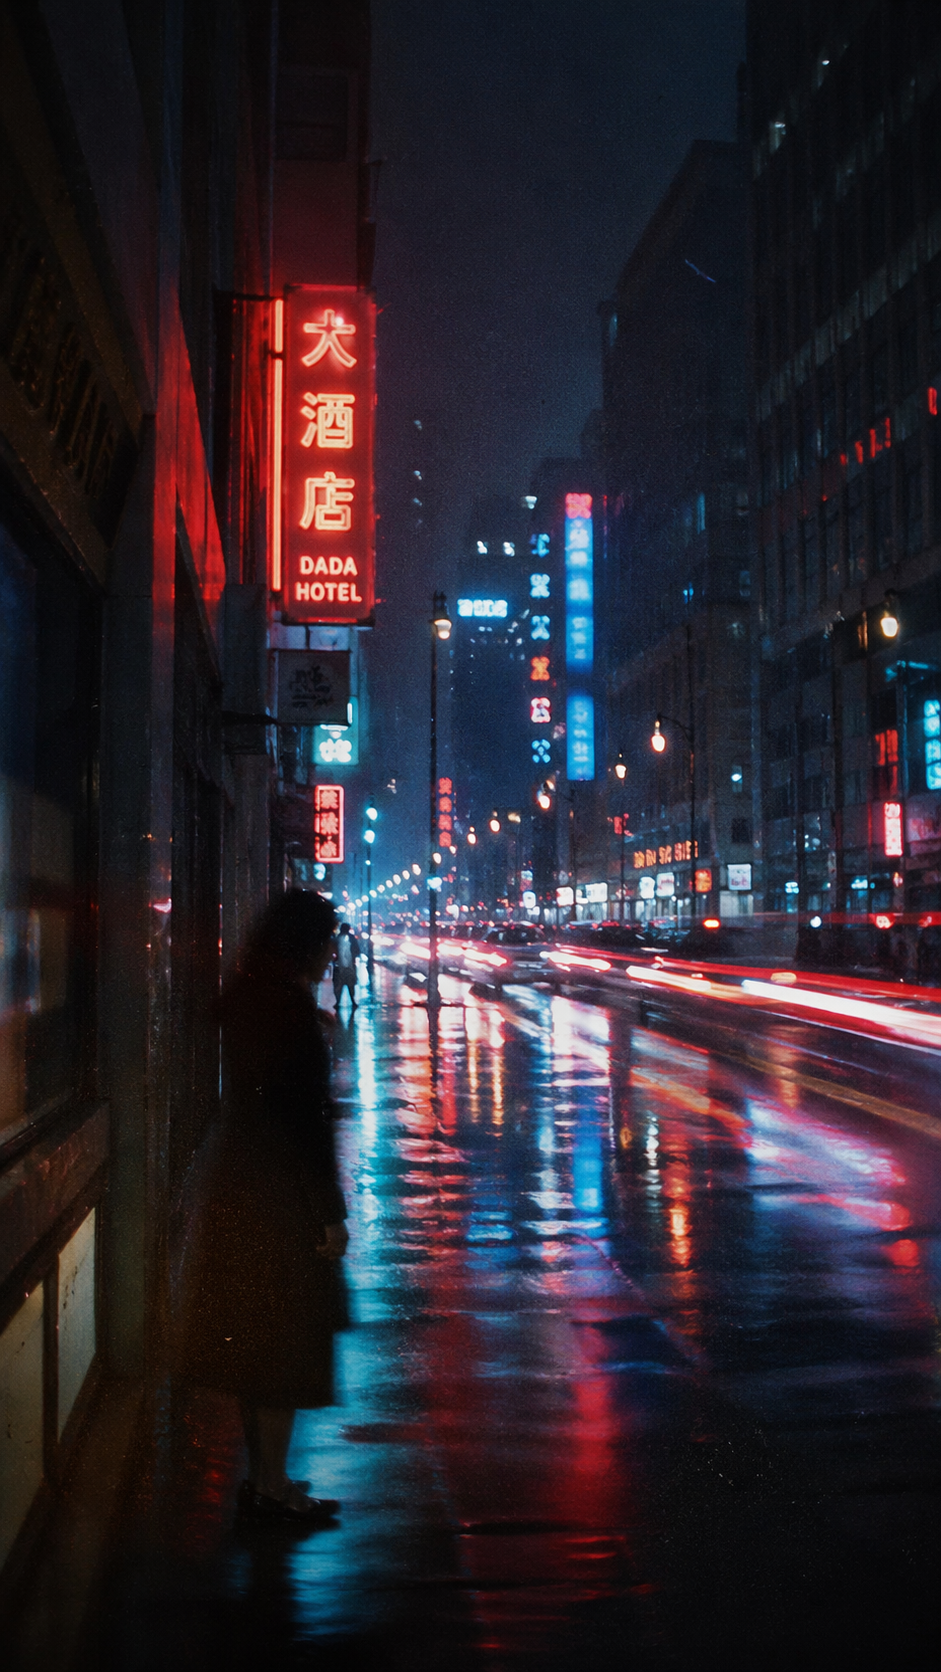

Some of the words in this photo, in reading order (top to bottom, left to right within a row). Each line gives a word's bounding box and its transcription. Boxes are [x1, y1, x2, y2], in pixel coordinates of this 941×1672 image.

[300, 309, 356, 531] 大酒店
[300, 556, 357, 576] DADA
[296, 582, 362, 602] HOTEL
